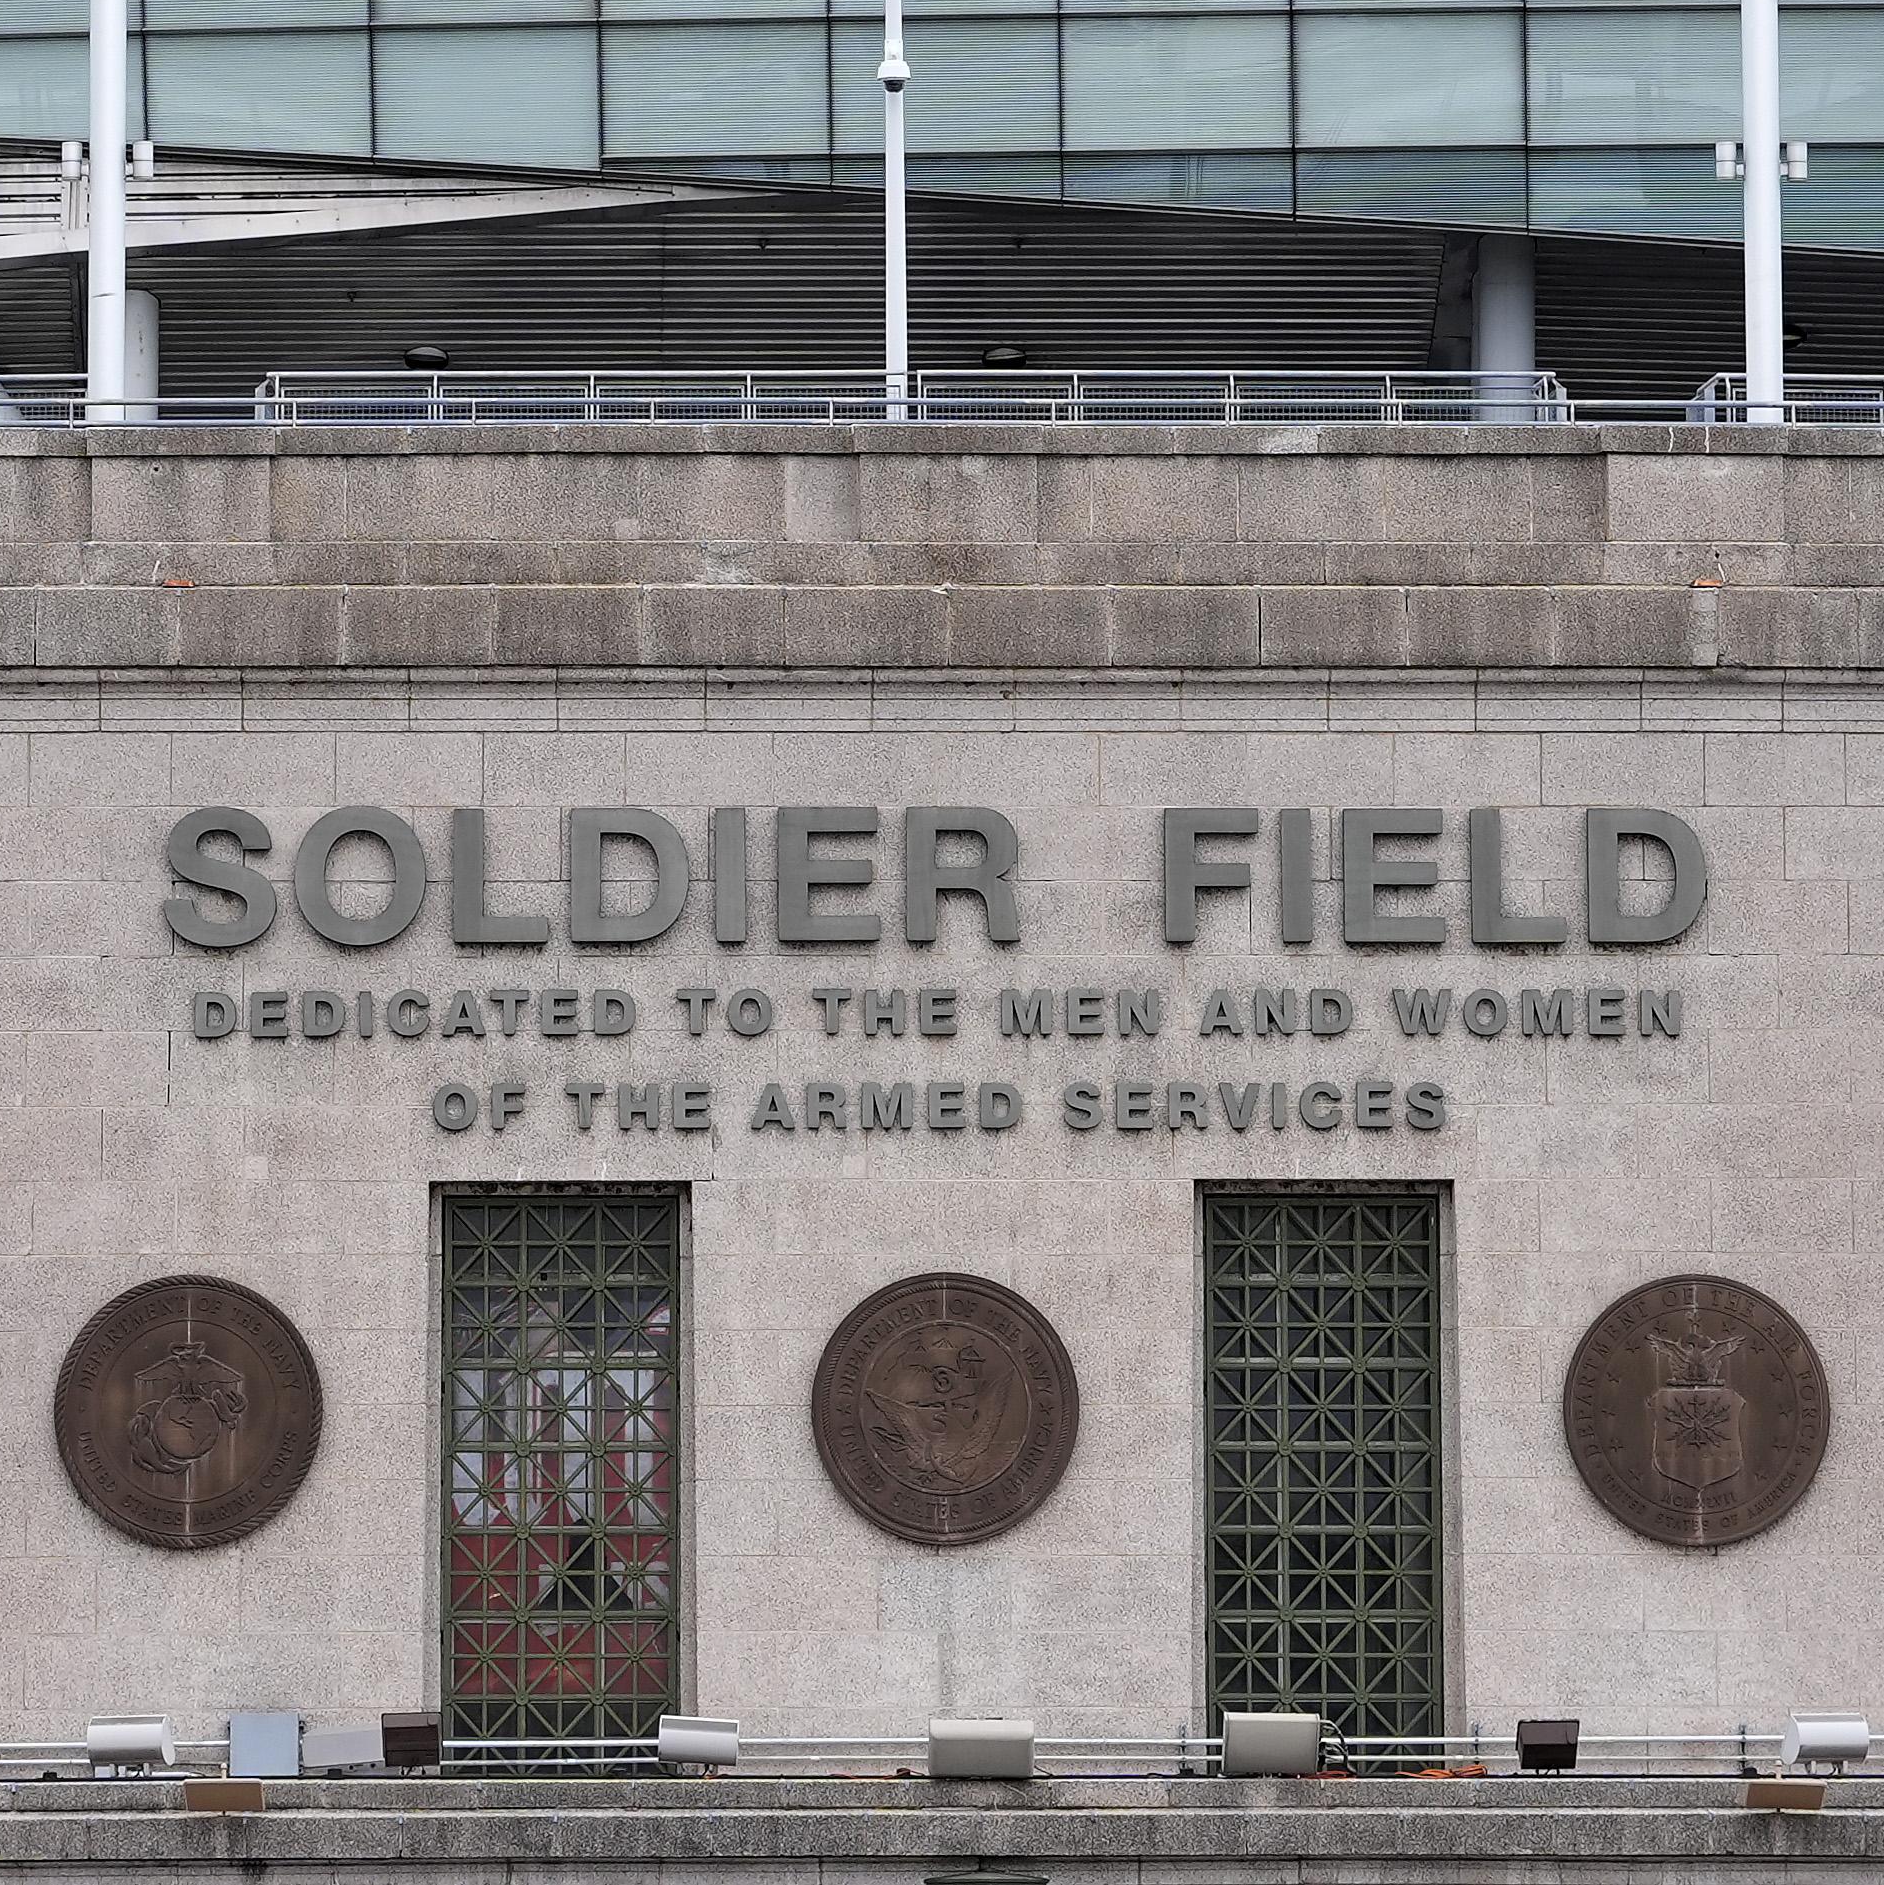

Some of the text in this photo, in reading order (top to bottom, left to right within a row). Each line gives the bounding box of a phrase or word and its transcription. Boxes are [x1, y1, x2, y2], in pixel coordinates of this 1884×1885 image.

[162, 805, 1707, 948] SOLDIER FIELD
[193, 987, 1683, 1039] DEDICATED TO THE MEN AND WOMEN
[431, 1081, 1447, 1132] OF THE ARMED SERVICES
